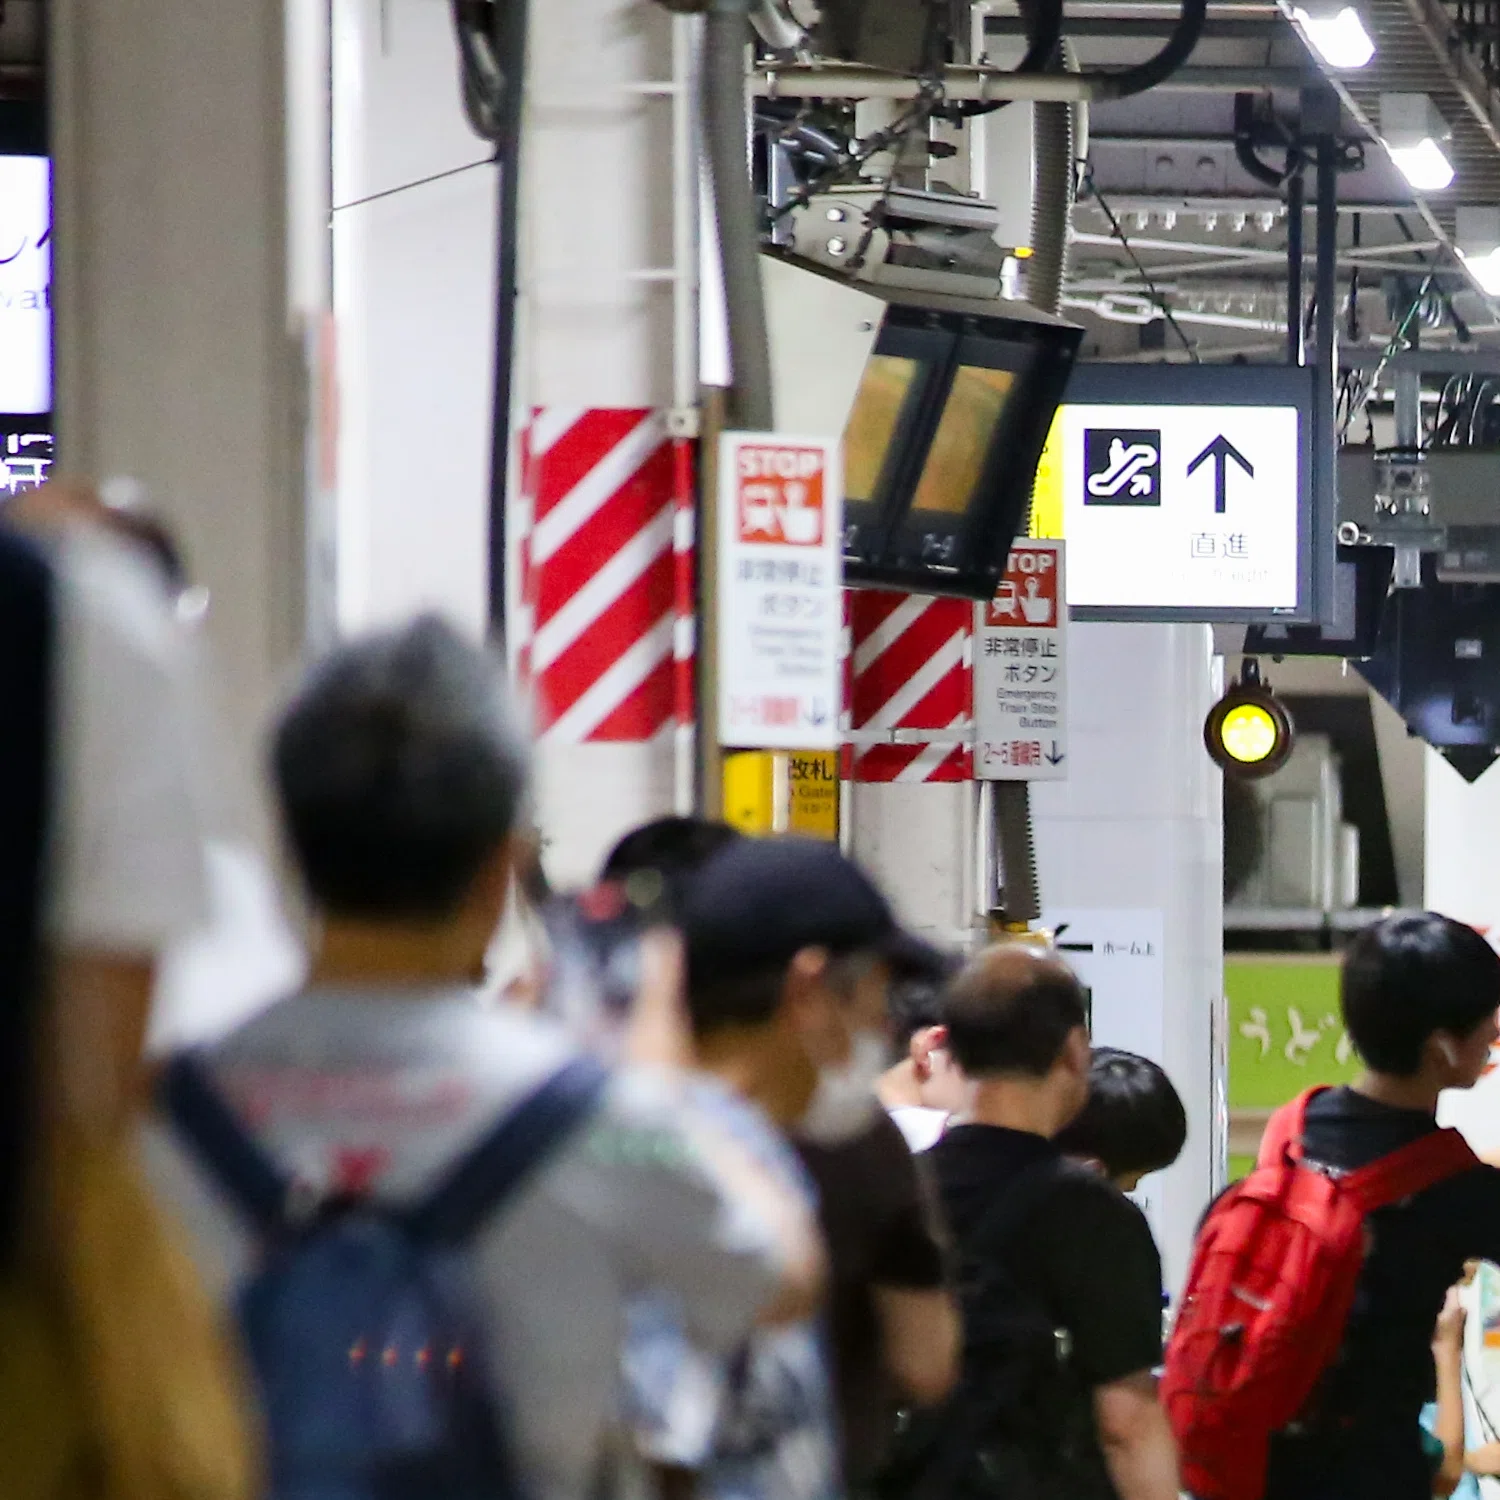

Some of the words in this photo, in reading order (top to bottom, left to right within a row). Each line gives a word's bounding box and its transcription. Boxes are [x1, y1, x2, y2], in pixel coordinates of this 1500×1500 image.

[1191, 532, 1249, 559] 直進
[1006, 552, 1055, 574] TOP
[984, 637, 1058, 658] 非常停止
[1004, 664, 1057, 683] ボタン
[996, 687, 1058, 701] Emergency
[1000, 702, 1028, 714] Train
[1030, 702, 1058, 715] Stop
[1019, 716, 1057, 729] Button
